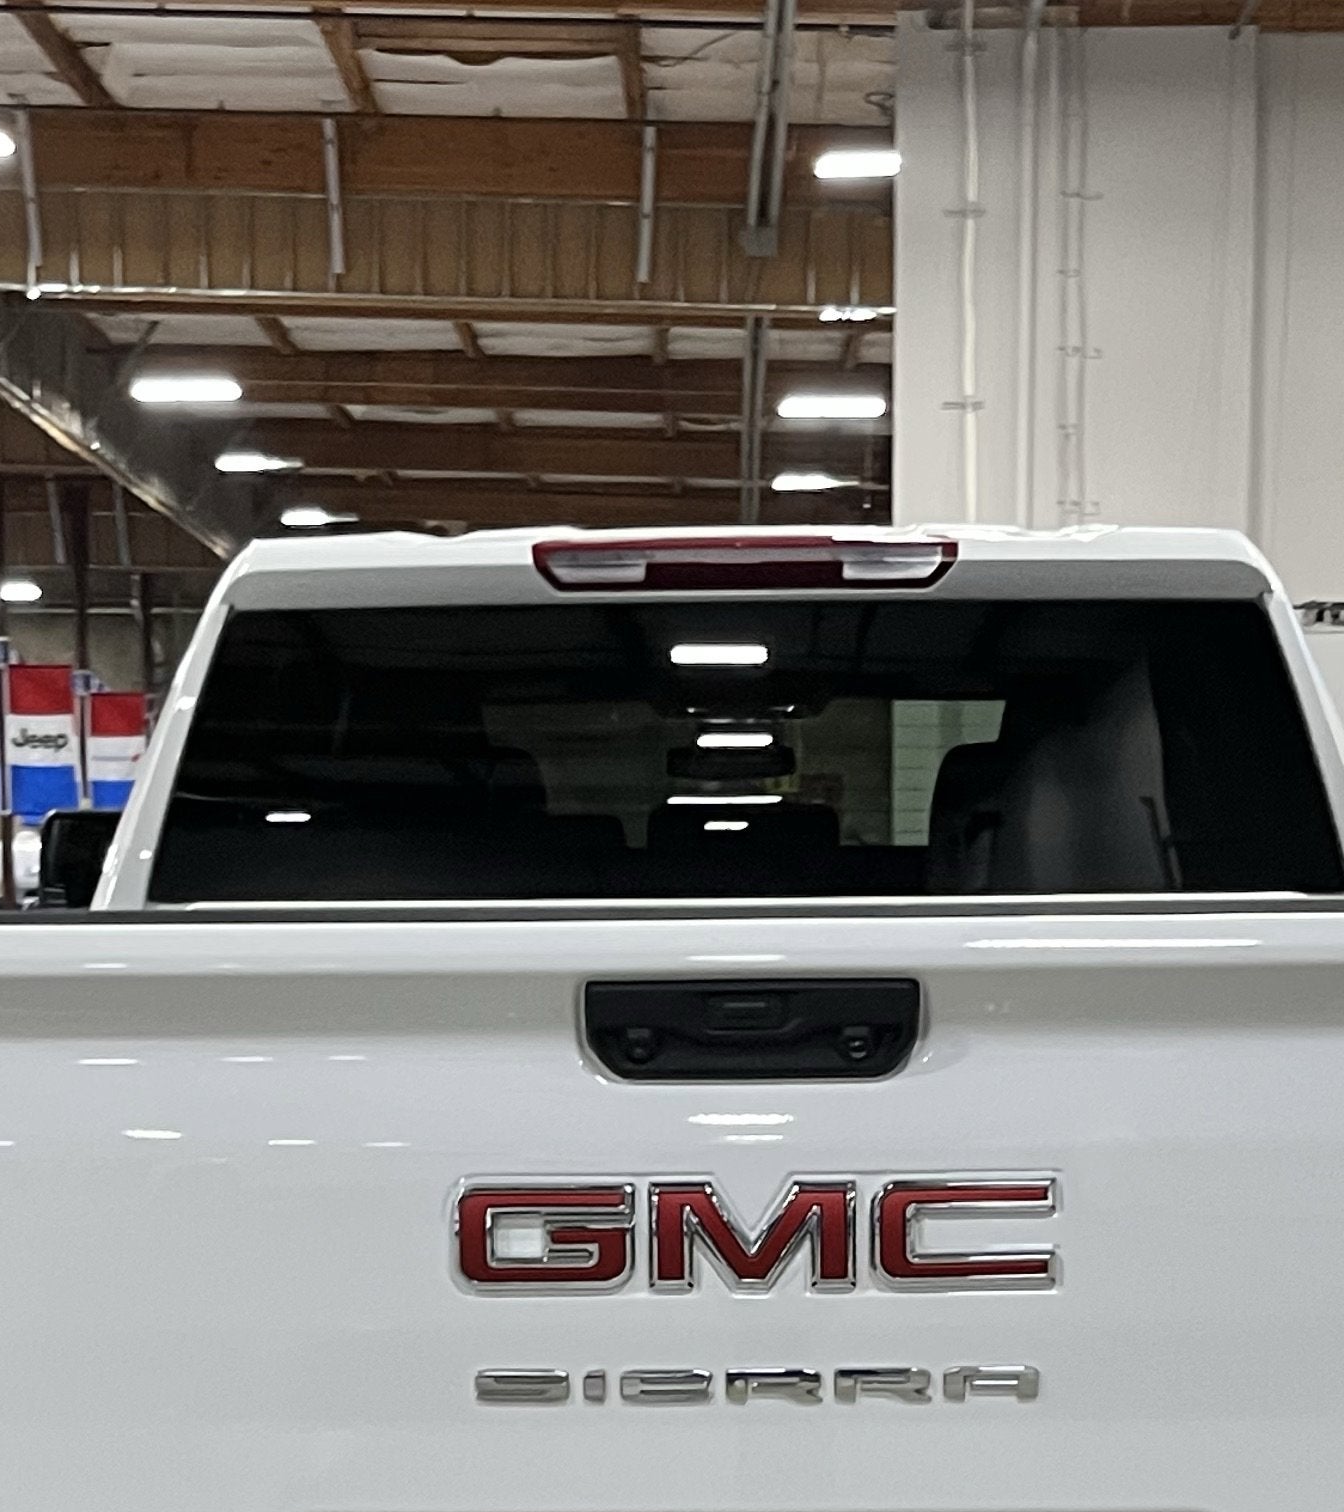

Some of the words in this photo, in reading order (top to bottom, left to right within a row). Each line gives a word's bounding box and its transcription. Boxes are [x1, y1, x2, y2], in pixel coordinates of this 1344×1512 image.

[11, 727, 69, 753] Jeep
[455, 1176, 1058, 1295] GMC
[474, 1366, 1040, 1402] SIERRA
